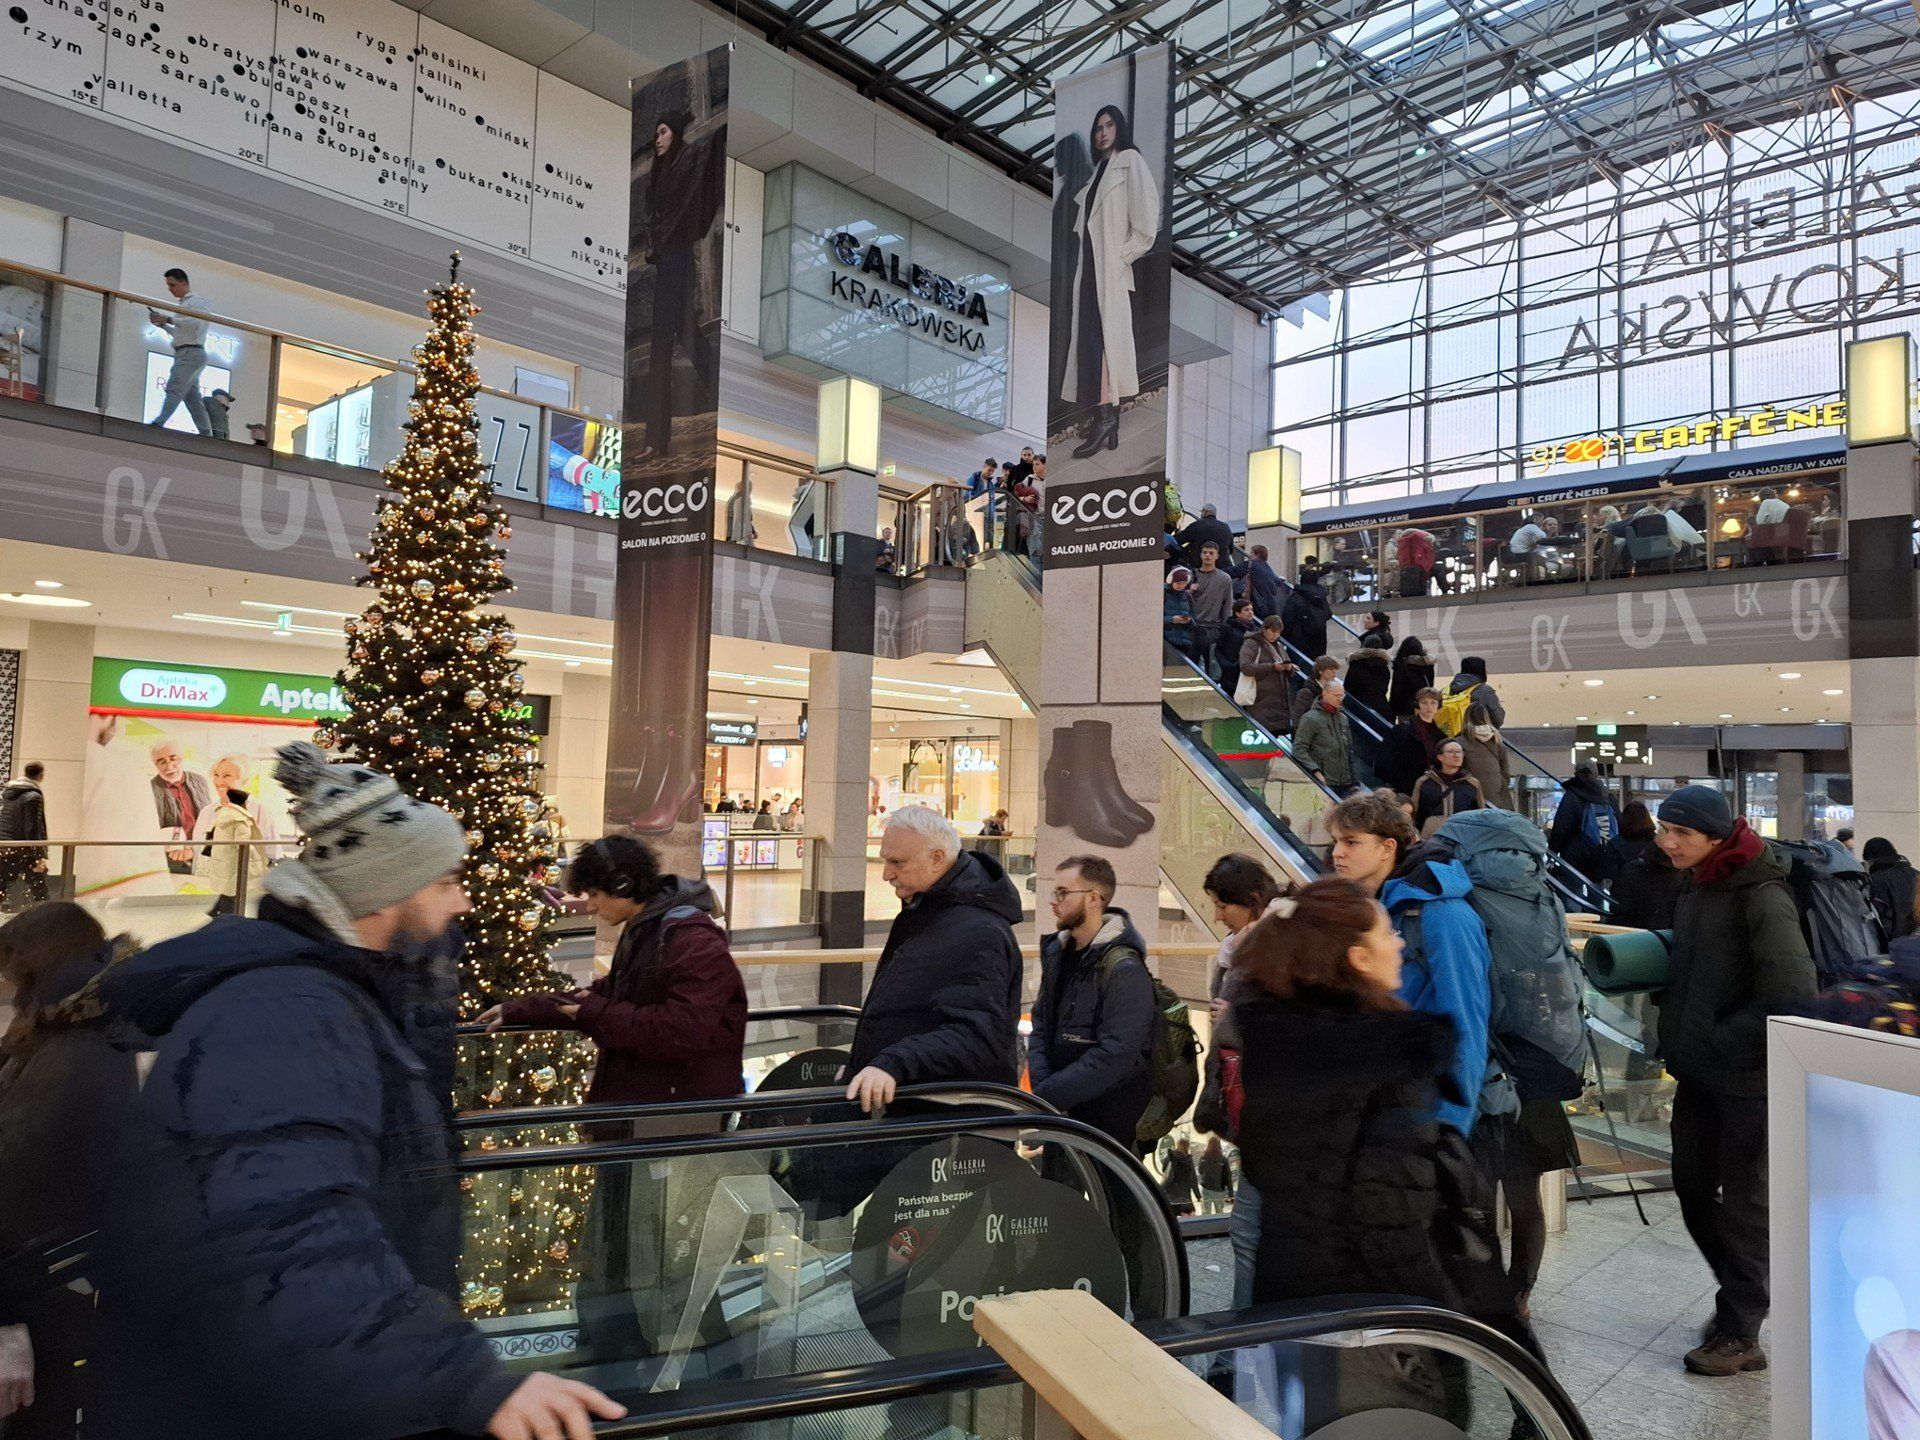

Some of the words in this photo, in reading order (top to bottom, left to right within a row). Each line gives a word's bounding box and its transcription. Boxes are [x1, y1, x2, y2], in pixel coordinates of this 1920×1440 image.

[24, 26, 82, 55] rzym
[97, 21, 189, 64] zagrzeb
[356, 30, 397, 55] ryga
[278, 54, 346, 90] kraków
[308, 47, 398, 92] warszawa
[419, 63, 463, 91] tallin
[420, 44, 487, 82] helsinki
[72, 89, 98, 105] 15°E
[92, 73, 181, 113] valletta
[161, 63, 260, 108] sarajewo
[249, 70, 349, 118] budapeszt
[424, 91, 467, 117] wilno
[245, 110, 303, 142] tirana
[306, 107, 376, 143] belgrad
[486, 123, 530, 150] mińsk
[238, 148, 264, 163] 20°E
[317, 133, 376, 163] skopje
[382, 151, 426, 175] sofia
[381, 167, 428, 194] ateny
[449, 164, 529, 204] bukareszt
[511, 171, 585, 210] kiszyniów
[556, 167, 594, 190] kijów
[382, 199, 405, 213] 25°E
[507, 242, 527, 255] 30°E
[571, 249, 622, 275] nikozja
[833, 231, 990, 327] GALERIA
[831, 270, 986, 352] KRAKOWSKA
[1531, 434, 1625, 473] green
[1786, 401, 1846, 431] NE
[1728, 470, 1754, 479] CAŁA
[1755, 462, 1804, 474] NADZIEJA
[1805, 460, 1817, 468] W
[622, 481, 708, 519] ecco
[1051, 485, 1157, 525] ecco
[621, 538, 648, 549] SALON
[648, 536, 661, 547] NA
[661, 532, 700, 545] POZIOMIE
[1051, 544, 1083, 556] SALON
[1084, 542, 1098, 553] NA
[1099, 537, 1147, 551] POZIOMIE
[140, 682, 208, 701] Dr.Max
[259, 682, 352, 714] Aptek
[931, 1157, 948, 1183] GK
[952, 1158, 986, 1171] GALERIA
[898, 1194, 940, 1207] Państwa
[941, 1189, 976, 1203] bezpie
[893, 1209, 912, 1223] jest
[914, 1207, 931, 1219] dla
[932, 1207, 950, 1217] nas
[985, 1213, 1004, 1244] GK
[1010, 1216, 1049, 1230] GALERIA
